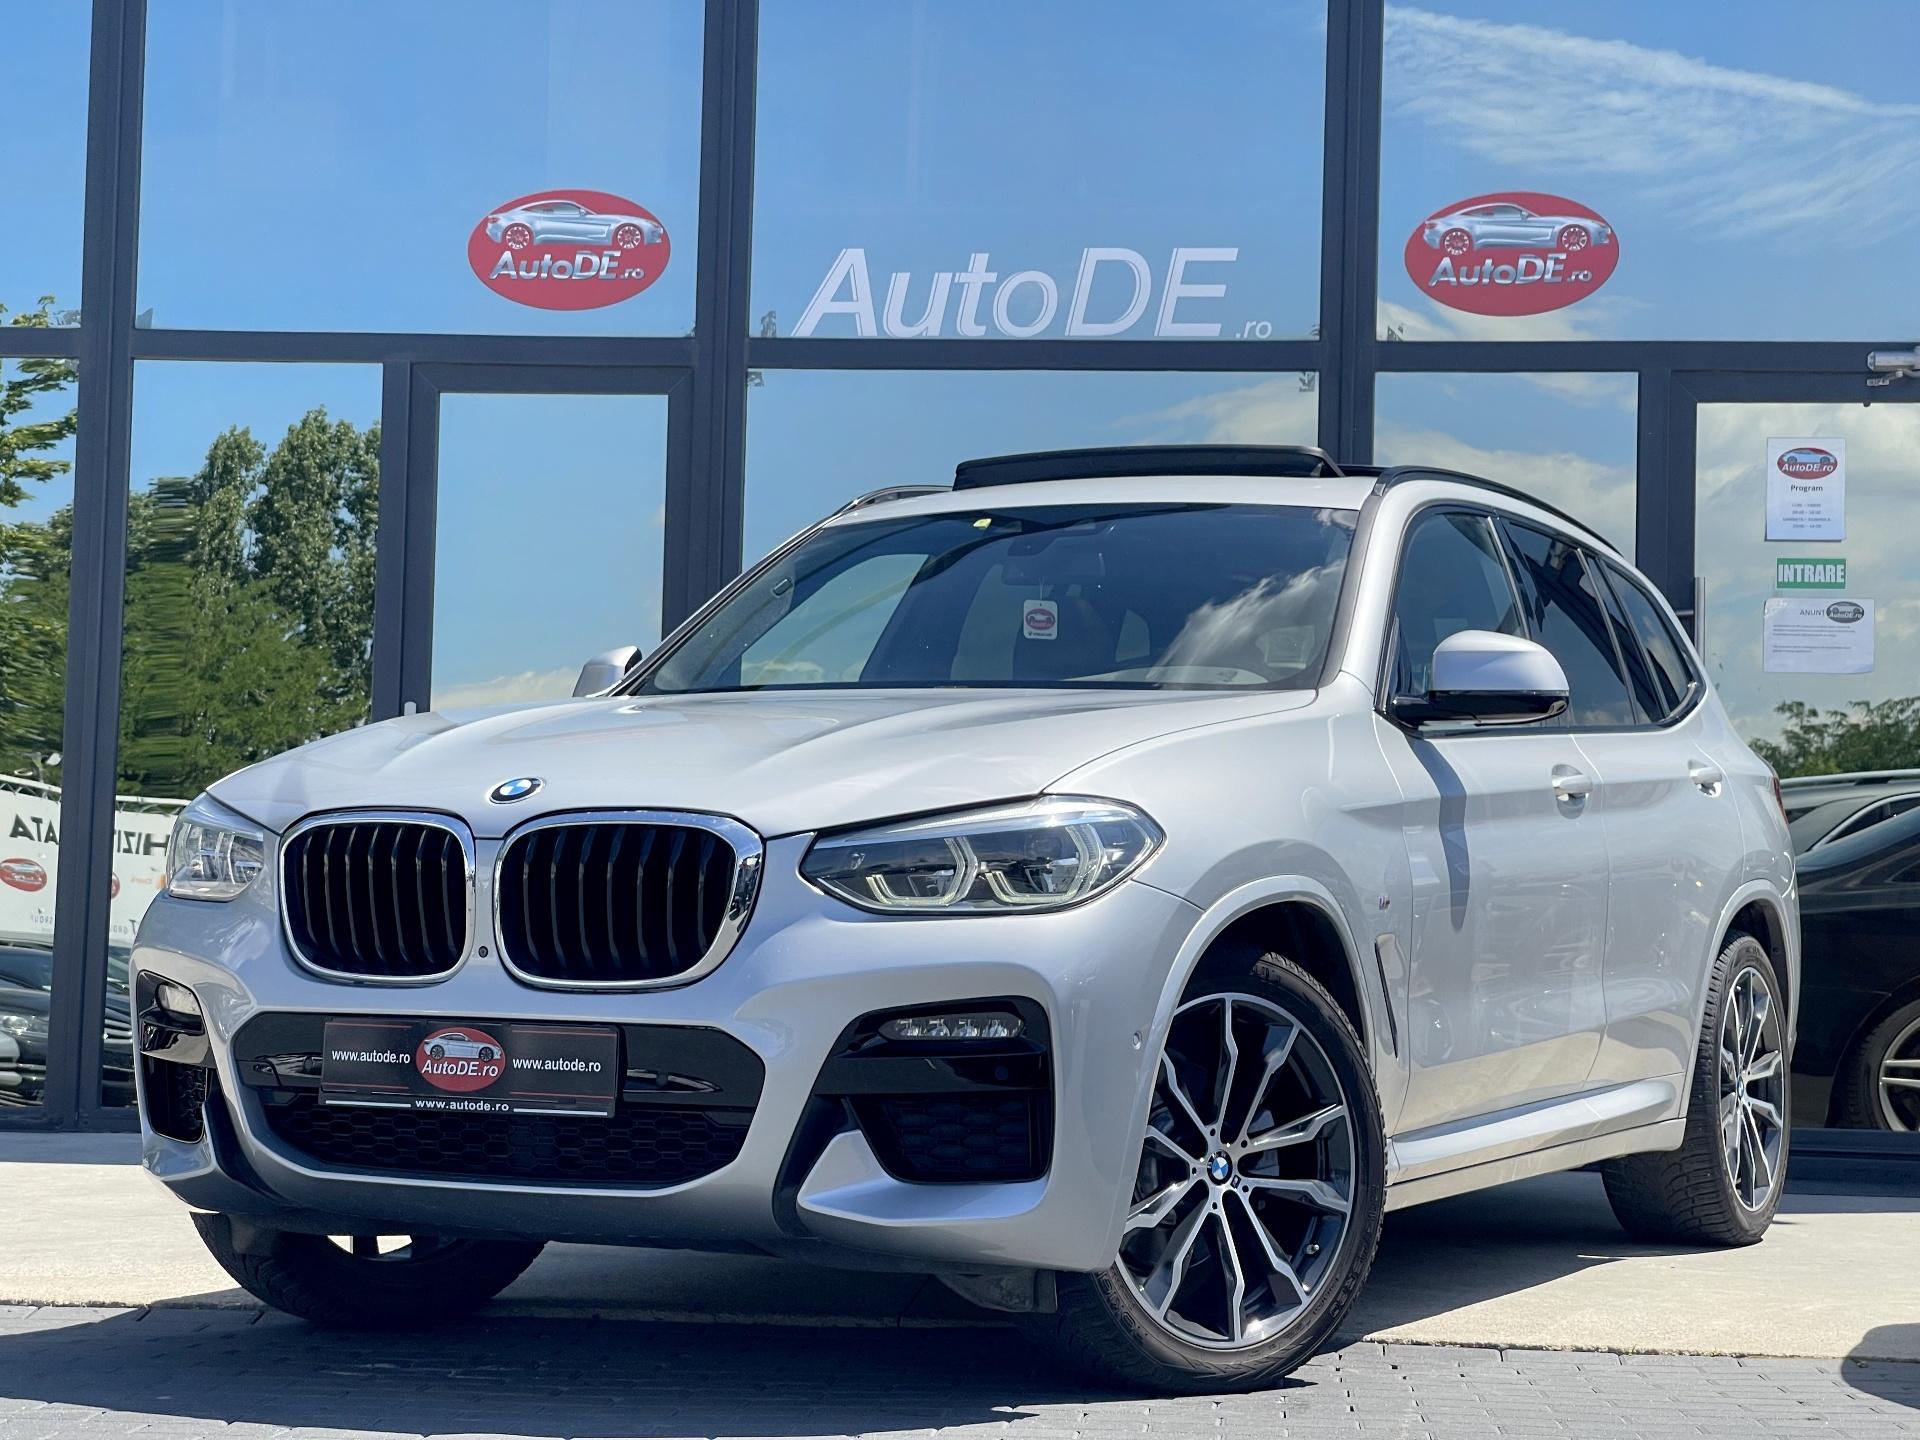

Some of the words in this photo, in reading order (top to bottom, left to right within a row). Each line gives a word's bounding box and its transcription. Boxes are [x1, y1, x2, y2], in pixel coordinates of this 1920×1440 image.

[489, 250, 645, 280] AutoDE.ro
[1428, 252, 1593, 287] AutoDE.ro
[1781, 463, 1834, 473] AutoDE.ro
[1790, 484, 1824, 493] Program
[1777, 564, 1845, 583] INTRARE
[331, 1049, 411, 1065] www.autode.ro
[512, 1057, 602, 1073] www.autode.ro
[421, 1060, 499, 1078] AutoDE.ro
[415, 1099, 510, 1112] www.autode.ro
